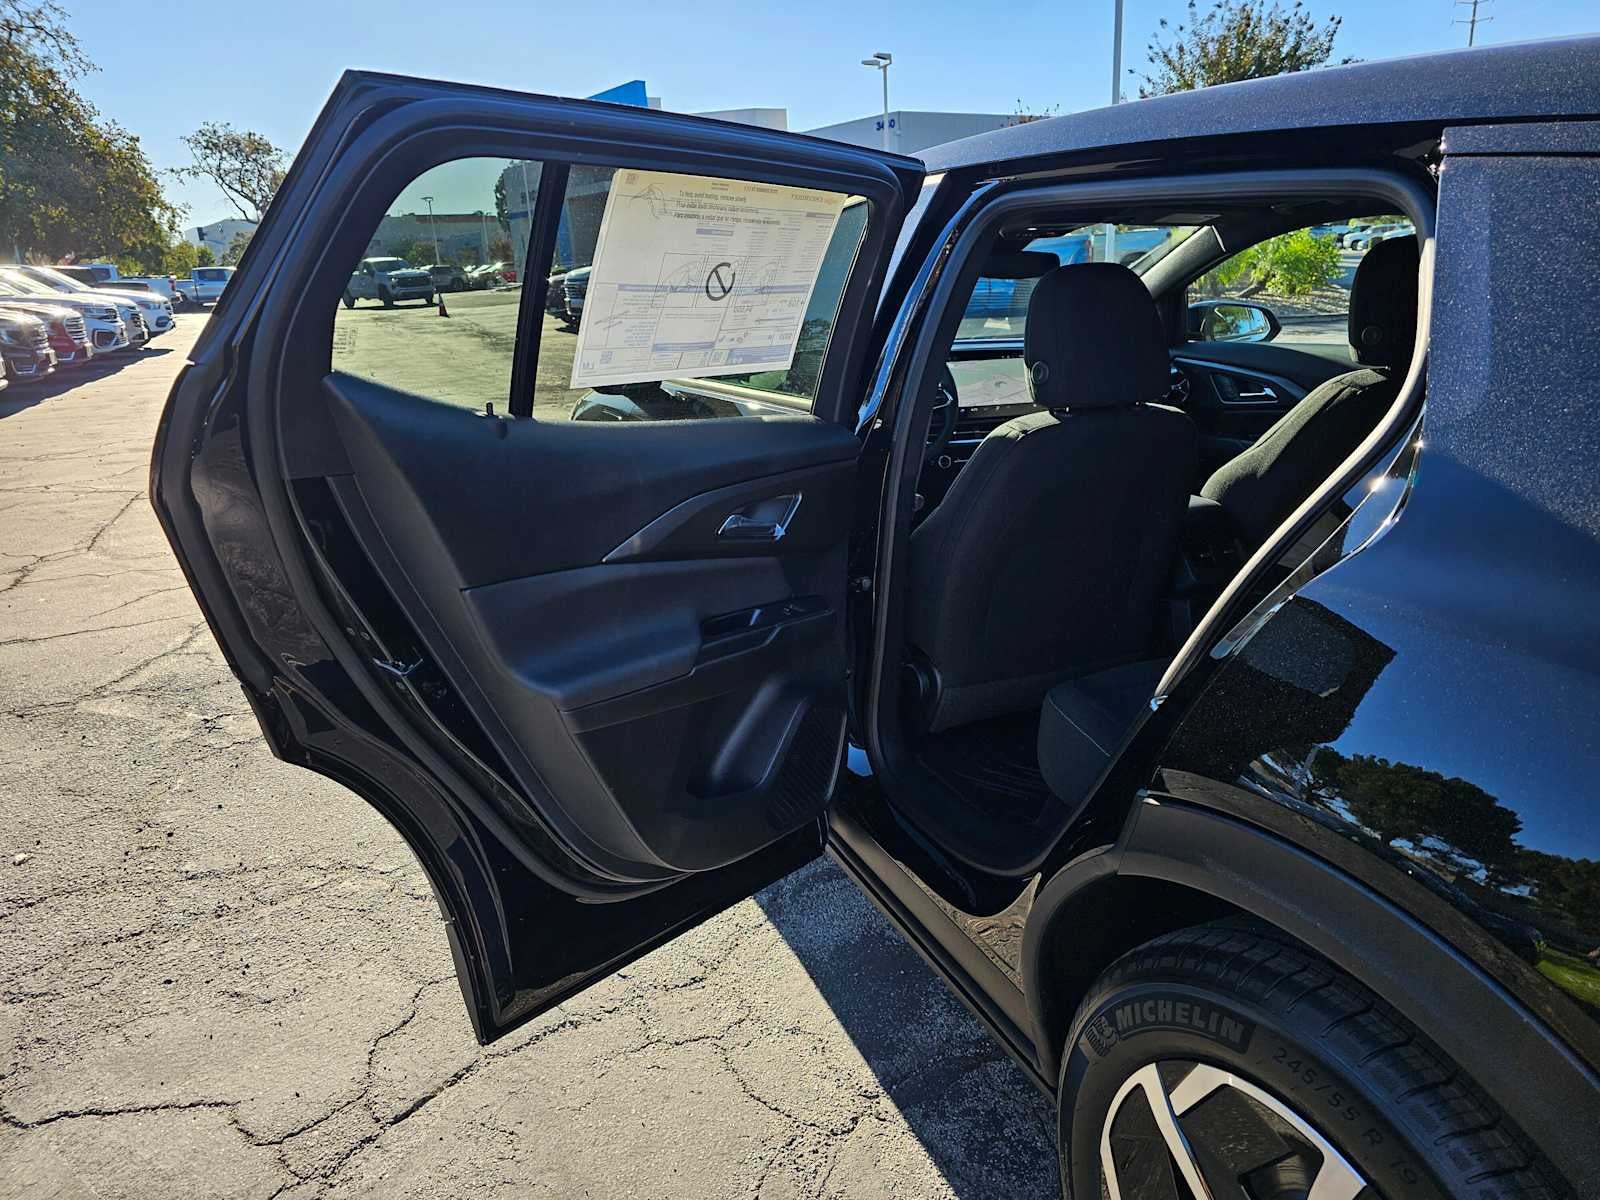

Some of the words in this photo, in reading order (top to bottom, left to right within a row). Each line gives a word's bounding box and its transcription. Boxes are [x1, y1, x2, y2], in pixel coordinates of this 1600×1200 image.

[1115, 999, 1245, 1043] MICHELIN
[1272, 1047, 1359, 1121] 245/55
[1361, 1128, 1384, 1147] R
[1391, 1160, 1417, 1184] 19
